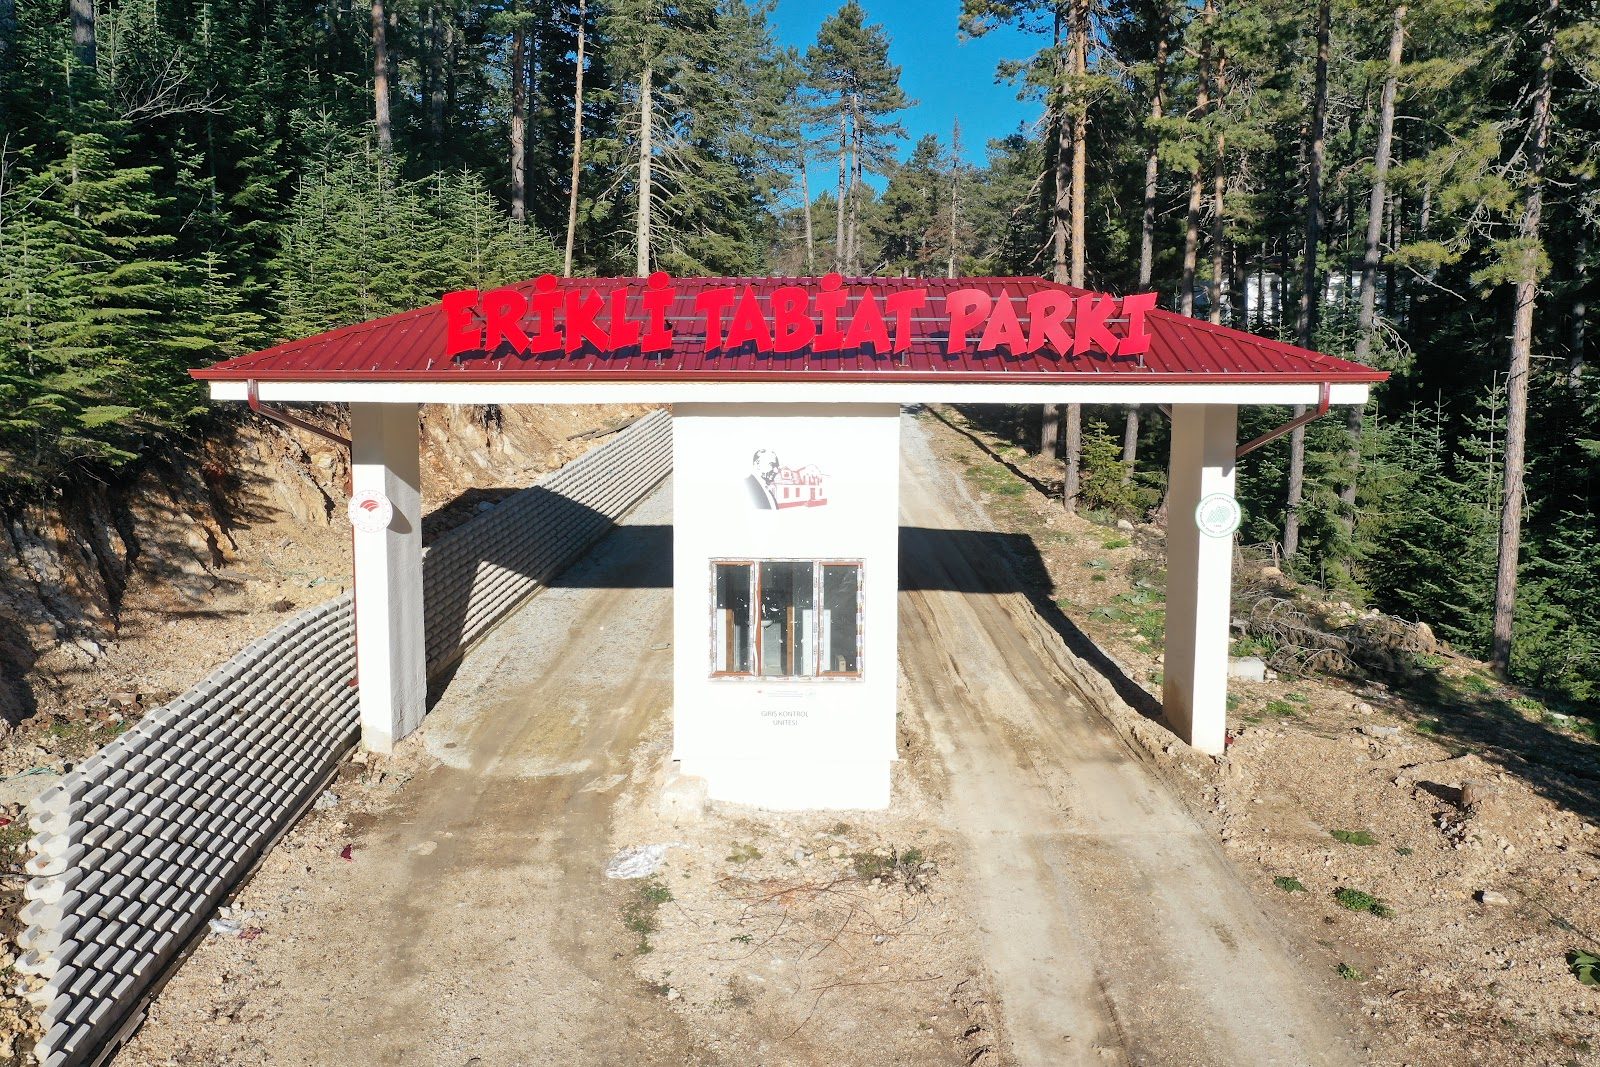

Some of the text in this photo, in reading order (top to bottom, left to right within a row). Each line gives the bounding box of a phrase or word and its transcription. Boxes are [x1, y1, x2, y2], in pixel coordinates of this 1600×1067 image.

[442, 271, 1158, 357] ERİKLİ TABİAT PARKI
